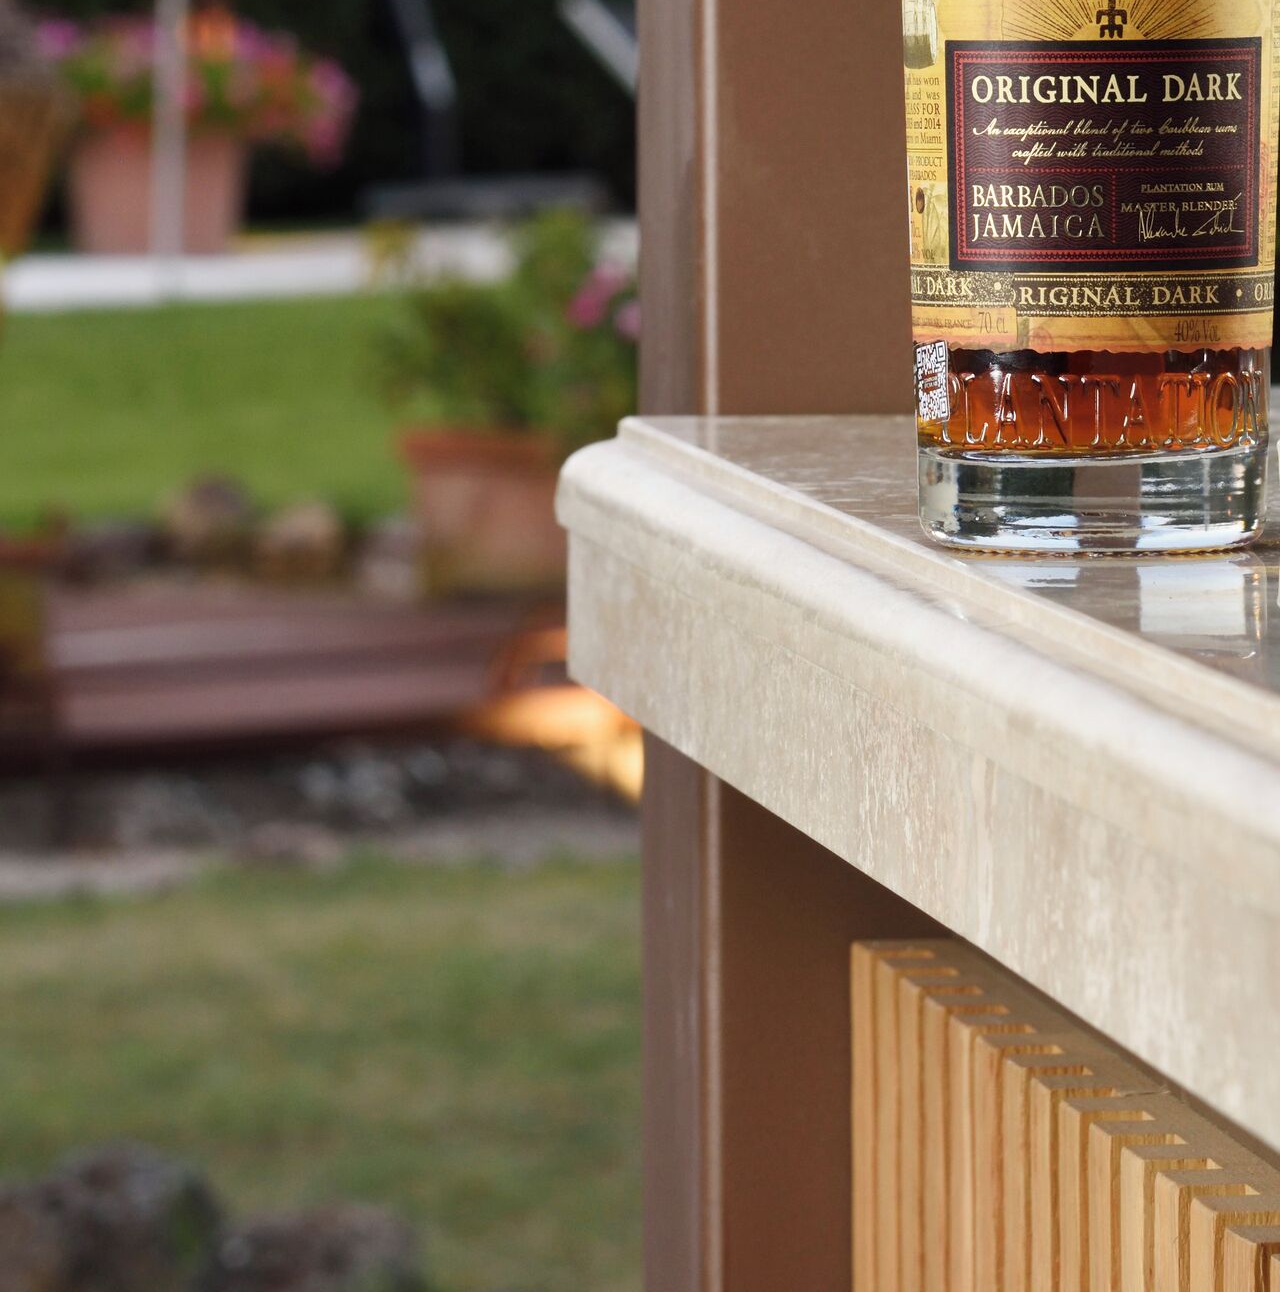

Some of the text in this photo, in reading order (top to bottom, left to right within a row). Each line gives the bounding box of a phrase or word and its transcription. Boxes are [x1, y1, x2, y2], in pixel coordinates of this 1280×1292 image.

[971, 72, 1242, 104] ORIGINAL DARK
[922, 102, 941, 116] FOR
[923, 117, 942, 130] 2014
[972, 116, 1238, 144] An exceptional blend of two Caribbean rums
[1011, 139, 1205, 166] crafted with traditional methods
[972, 184, 1104, 209] BARBADOS
[1140, 182, 1224, 194] PLANTATION RUM
[1120, 202, 1176, 213] MASTER
[971, 213, 1105, 242] JAMAICA
[926, 276, 975, 296] DARK
[1010, 286, 1141, 306] RIGINAL
[1151, 285, 1220, 306] DARK
[977, 311, 992, 334] 70
[1174, 319, 1200, 342] 40%
